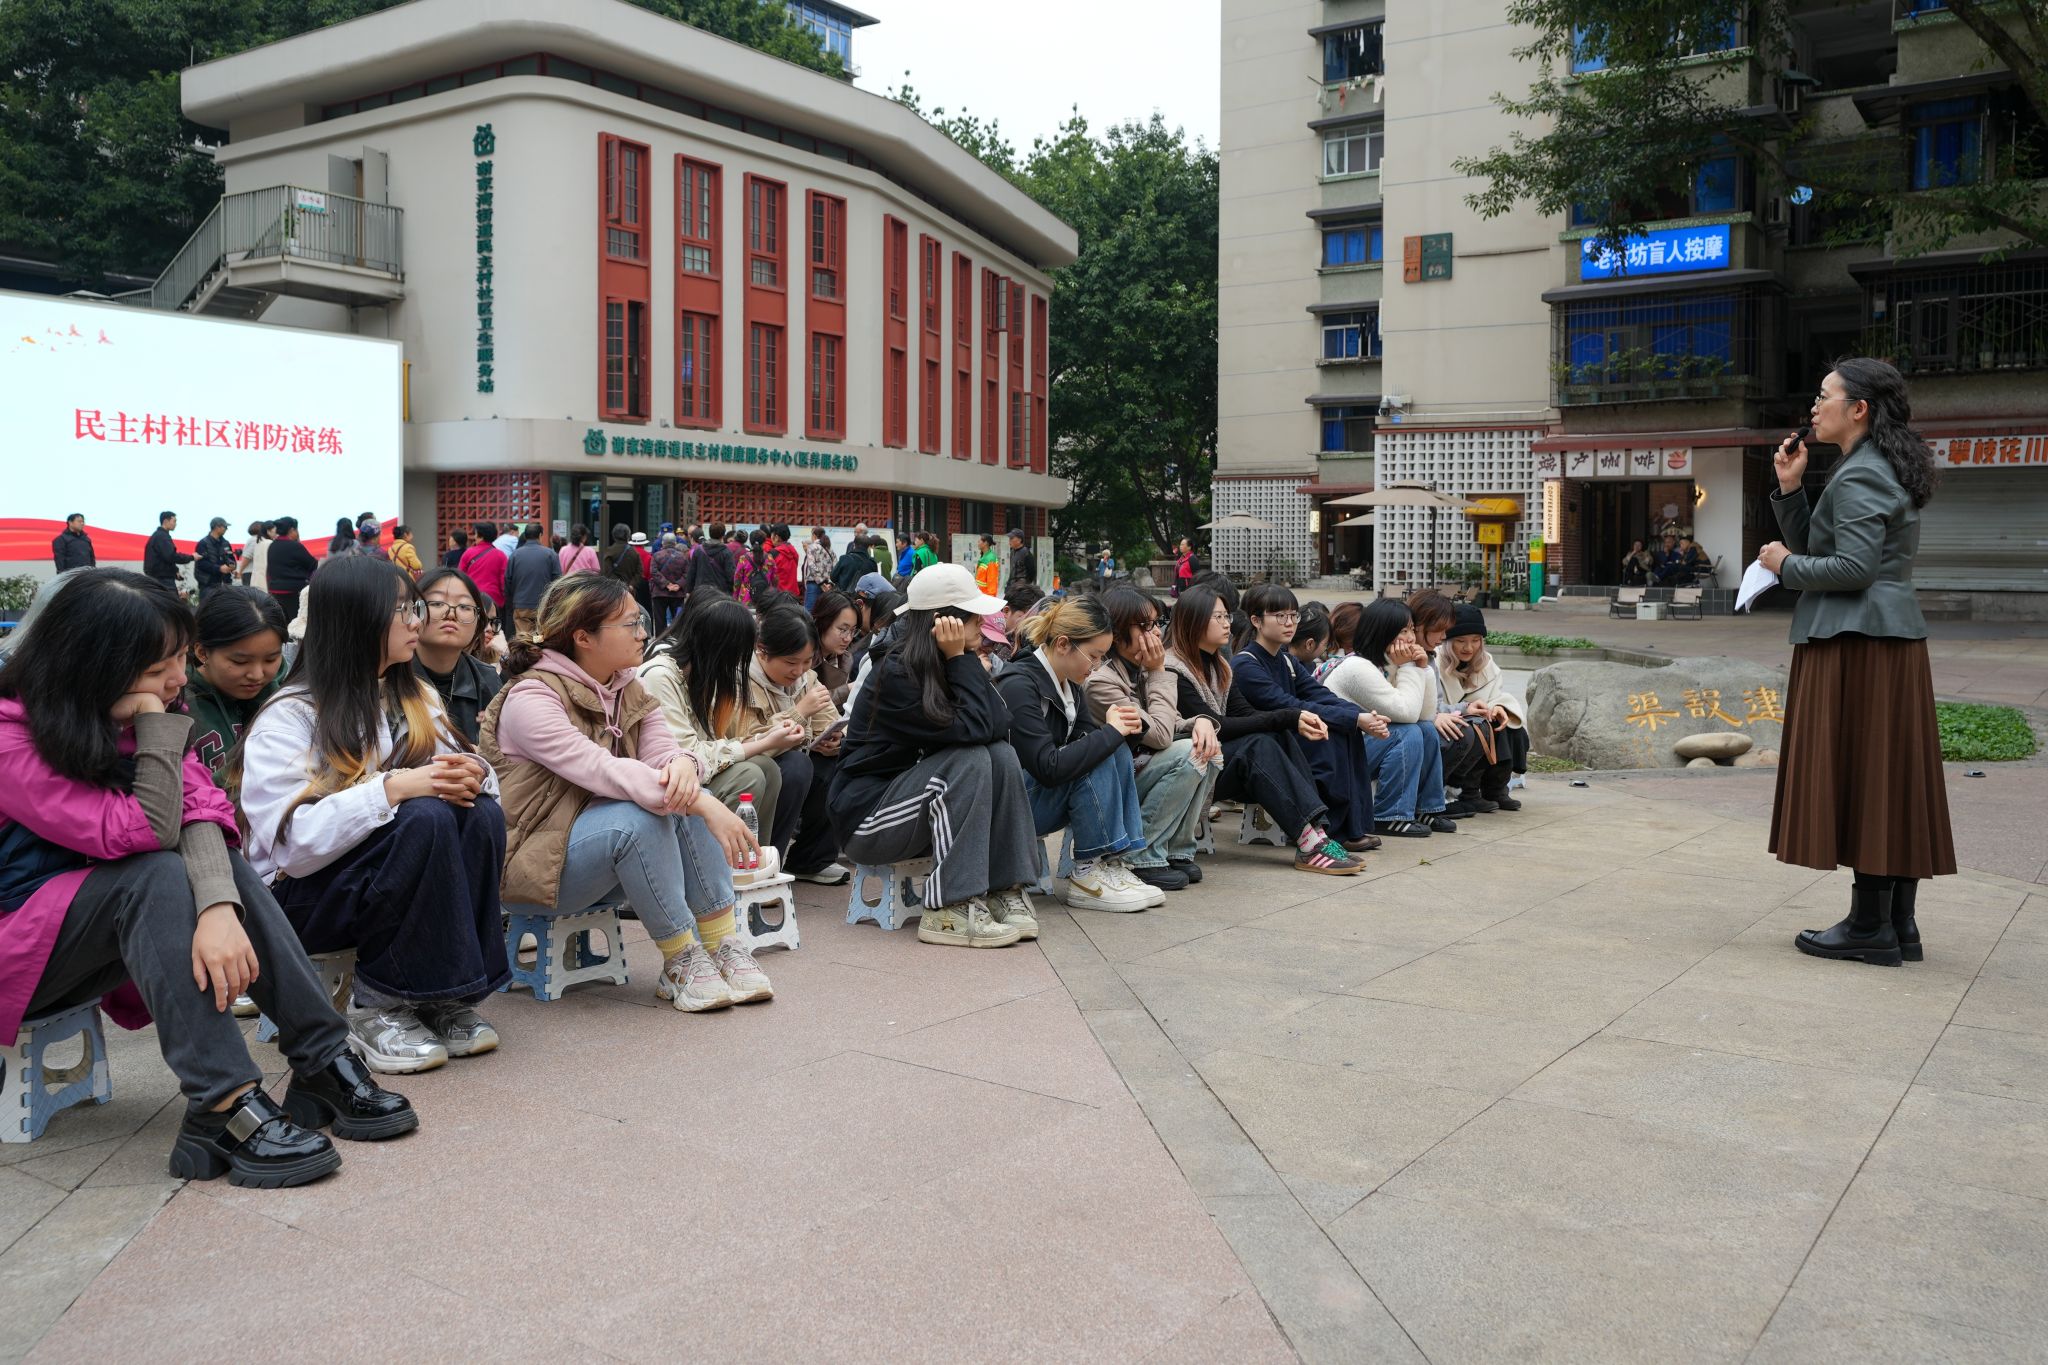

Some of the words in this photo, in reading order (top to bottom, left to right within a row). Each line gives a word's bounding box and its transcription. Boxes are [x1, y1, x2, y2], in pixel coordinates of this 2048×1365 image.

[75, 408, 343, 455] 民主村社区消防演练
